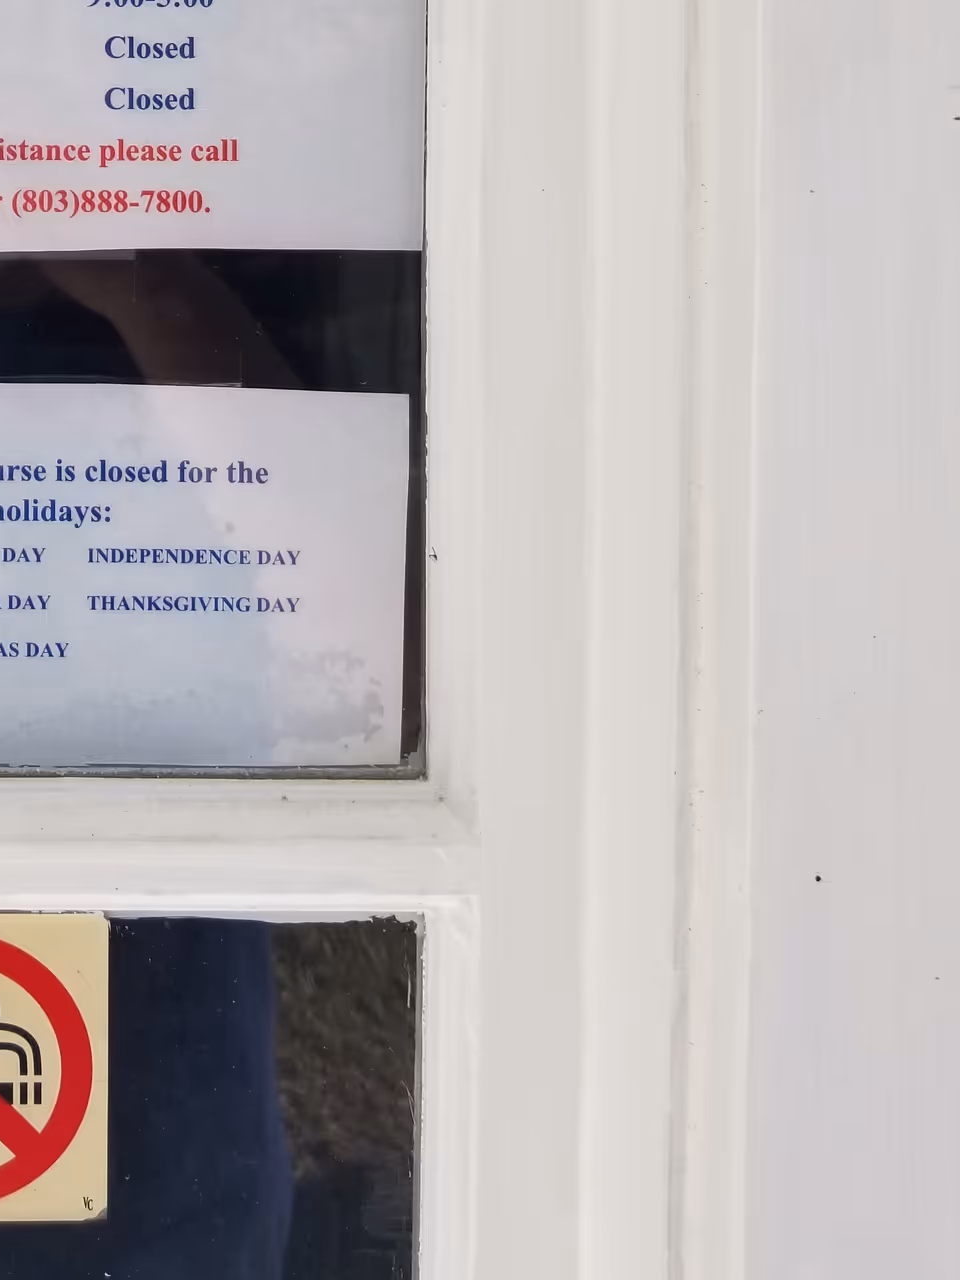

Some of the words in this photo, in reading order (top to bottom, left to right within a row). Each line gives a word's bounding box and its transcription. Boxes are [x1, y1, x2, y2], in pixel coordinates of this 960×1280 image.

[104, 35, 195, 59] Closed
[104, 86, 195, 110] Closed
[98, 138, 182, 168] please
[190, 138, 238, 161] call
[11, 189, 210, 218] (803)888-7800.
[54, 458, 75, 482] is
[84, 459, 168, 483] closed
[176, 459, 217, 483] for
[226, 460, 268, 484] the
[1, 547, 46, 562] DAY
[87, 547, 251, 565] INDEPENDENCE
[256, 549, 300, 565] DAY
[7, 594, 50, 609] DAY
[86, 595, 251, 612] THANKSGIVING
[256, 596, 300, 612] DAY
[24, 641, 69, 657] DAY
